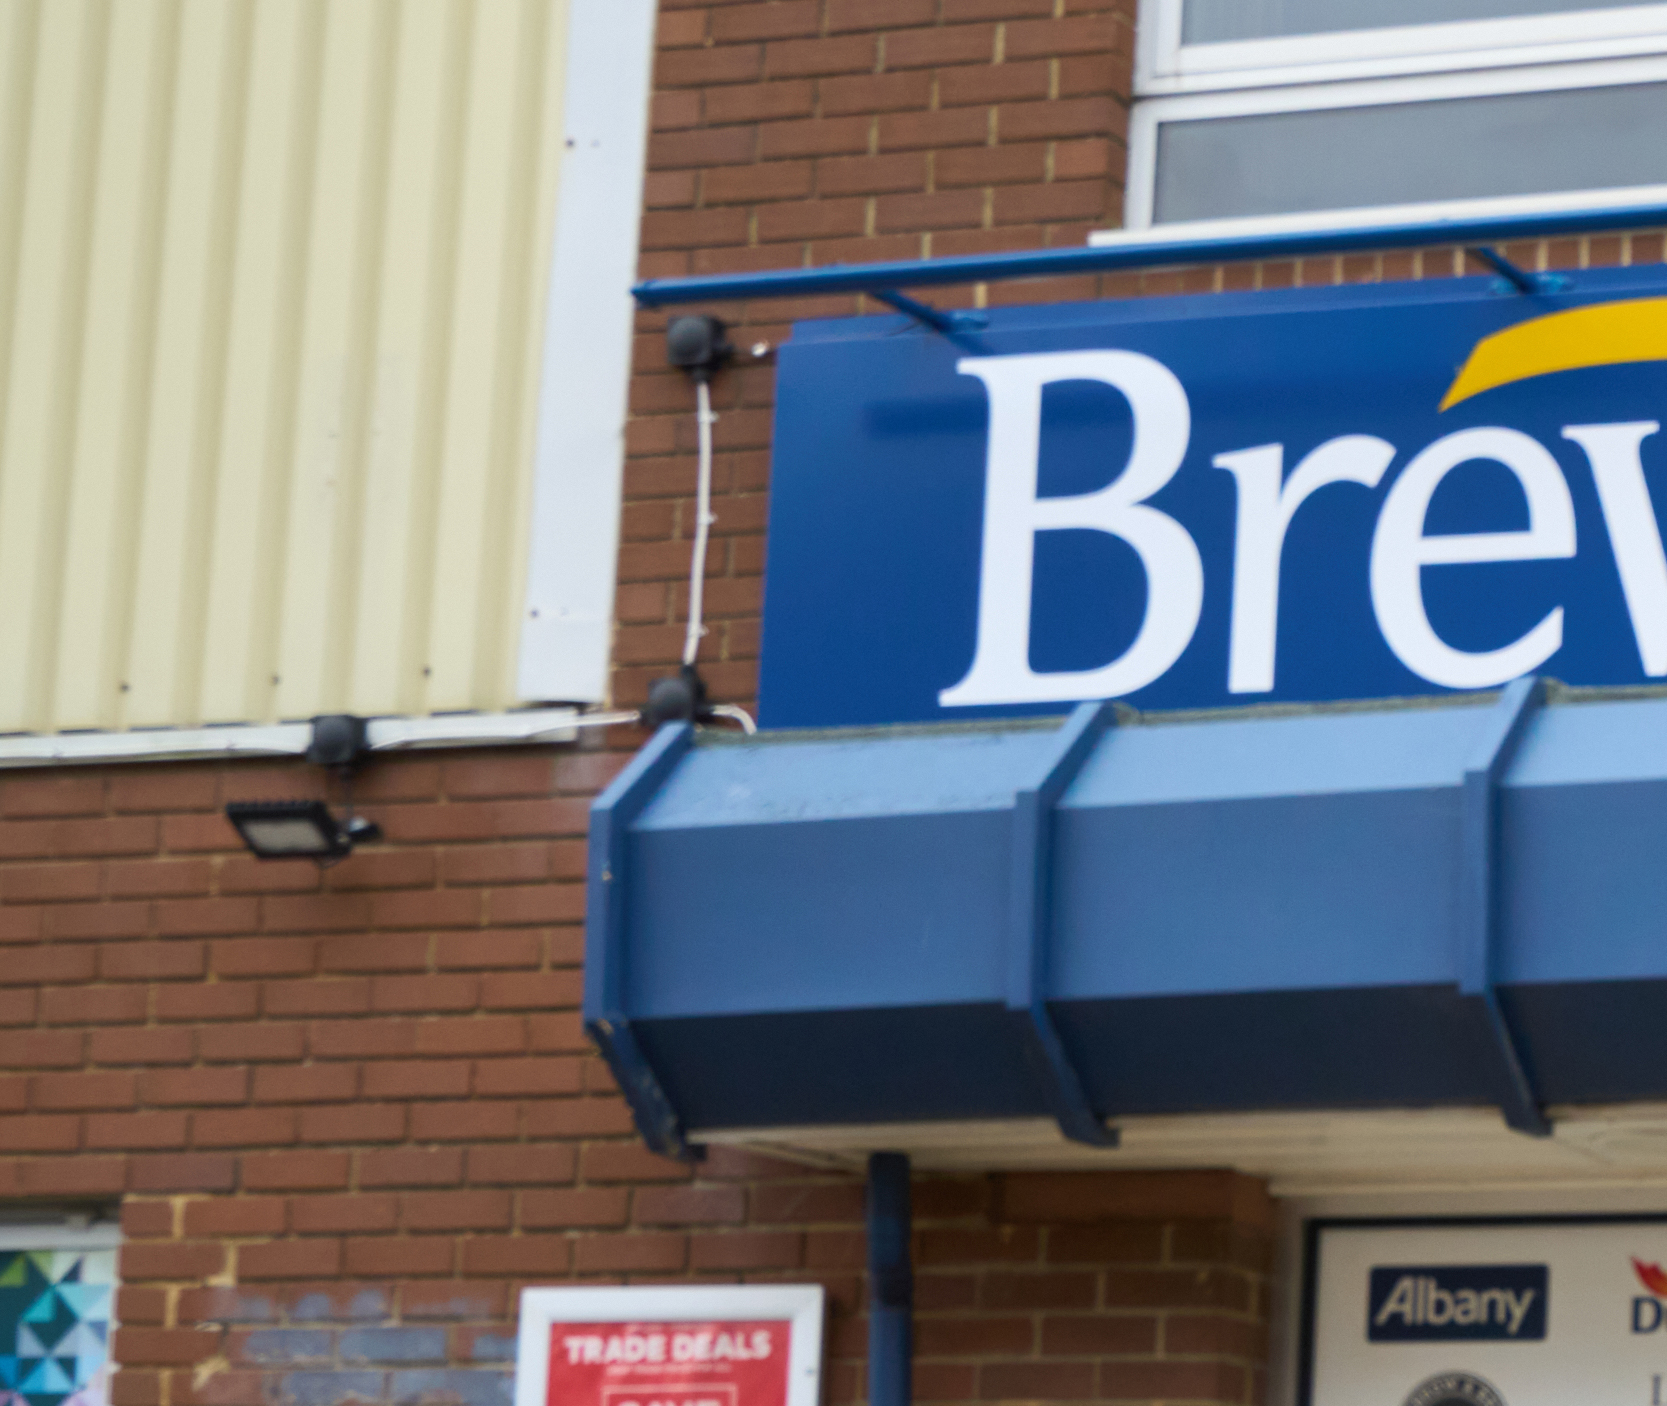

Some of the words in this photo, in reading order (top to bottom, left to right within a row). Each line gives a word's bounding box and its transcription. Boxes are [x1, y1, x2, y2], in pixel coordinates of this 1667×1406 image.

[1374, 1274, 1536, 1334] Albany
[563, 1333, 667, 1365] TRADE
[672, 1329, 773, 1361] DEALS
